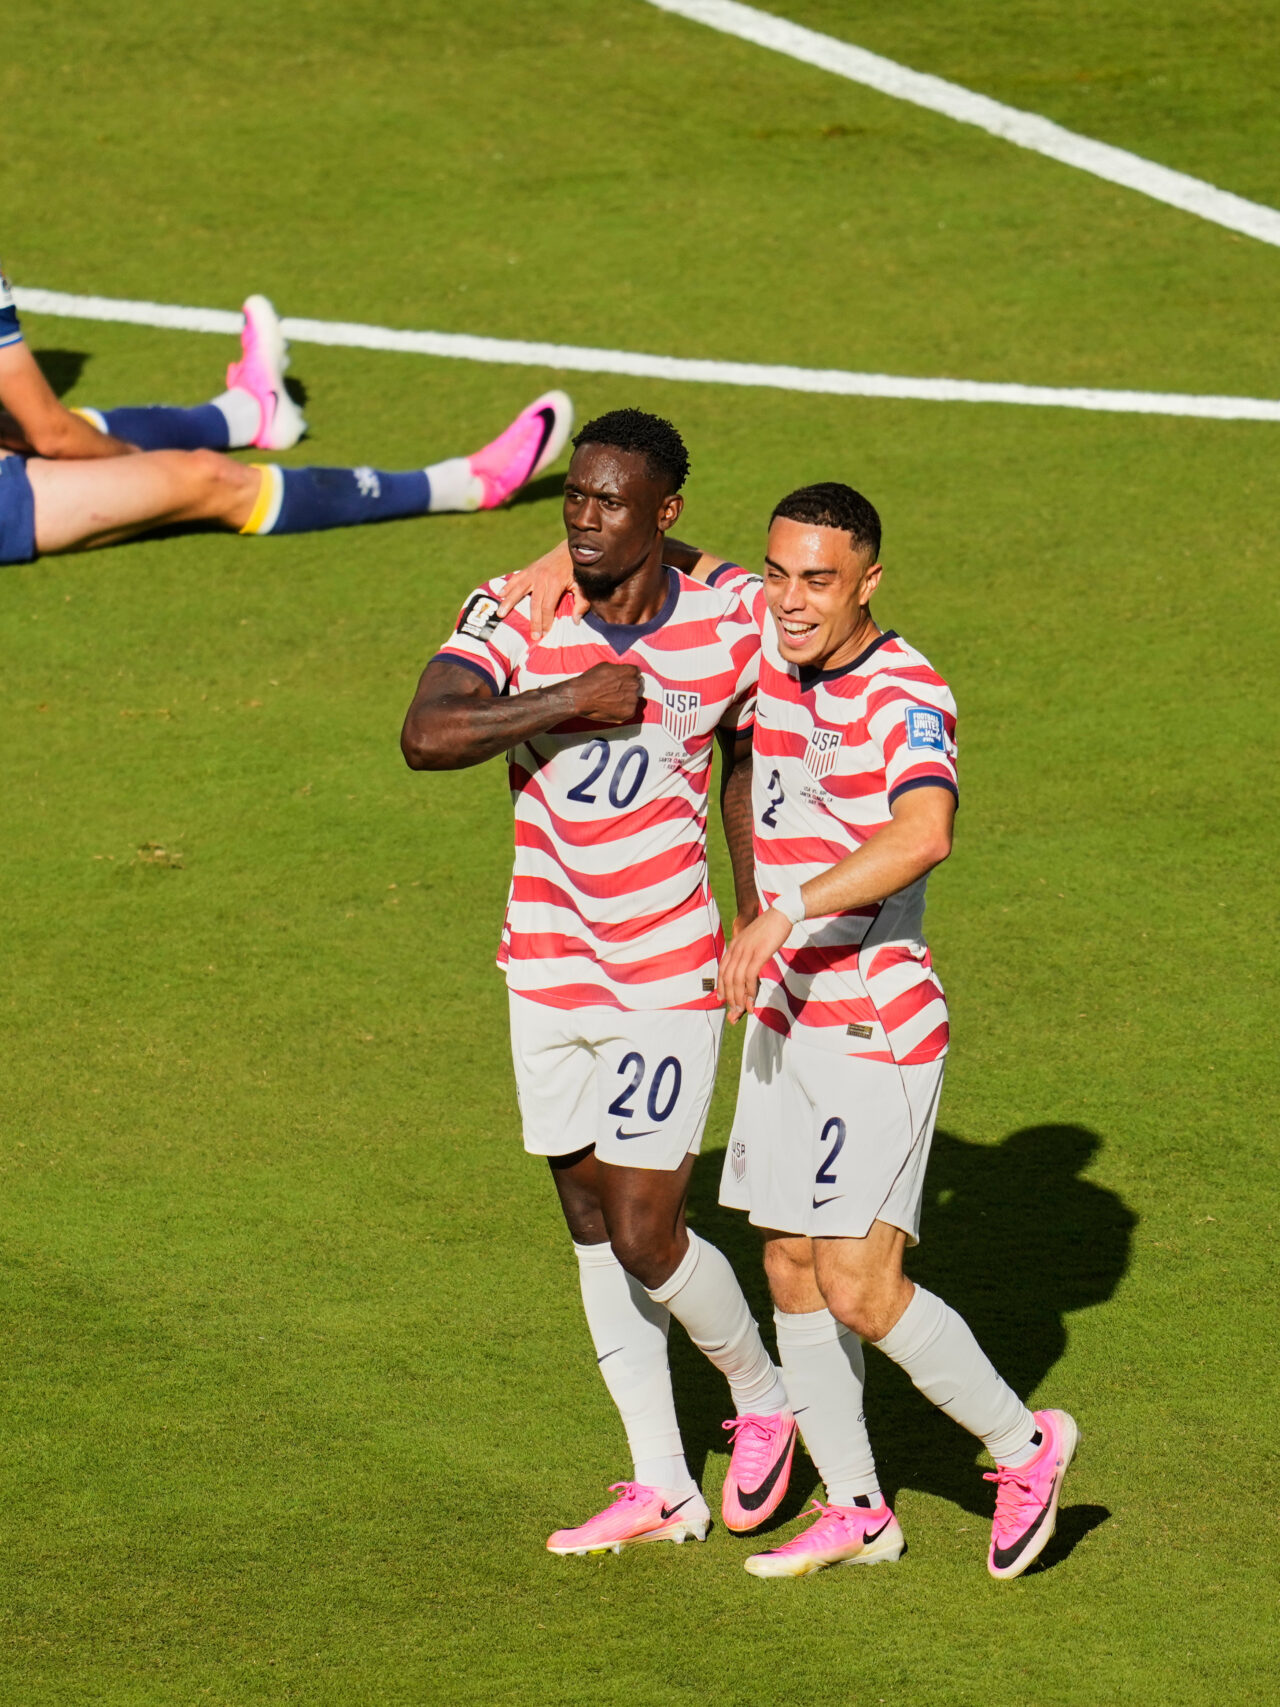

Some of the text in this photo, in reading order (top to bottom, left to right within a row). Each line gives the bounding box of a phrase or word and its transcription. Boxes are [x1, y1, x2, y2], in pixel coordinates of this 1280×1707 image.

[666, 692, 698, 713] USA
[913, 719, 940, 731] UNITES
[812, 730, 839, 751] USA
[566, 737, 649, 809] 20
[761, 769, 785, 829] 2
[607, 1051, 682, 1122] 20
[815, 1116, 847, 1184] 2
